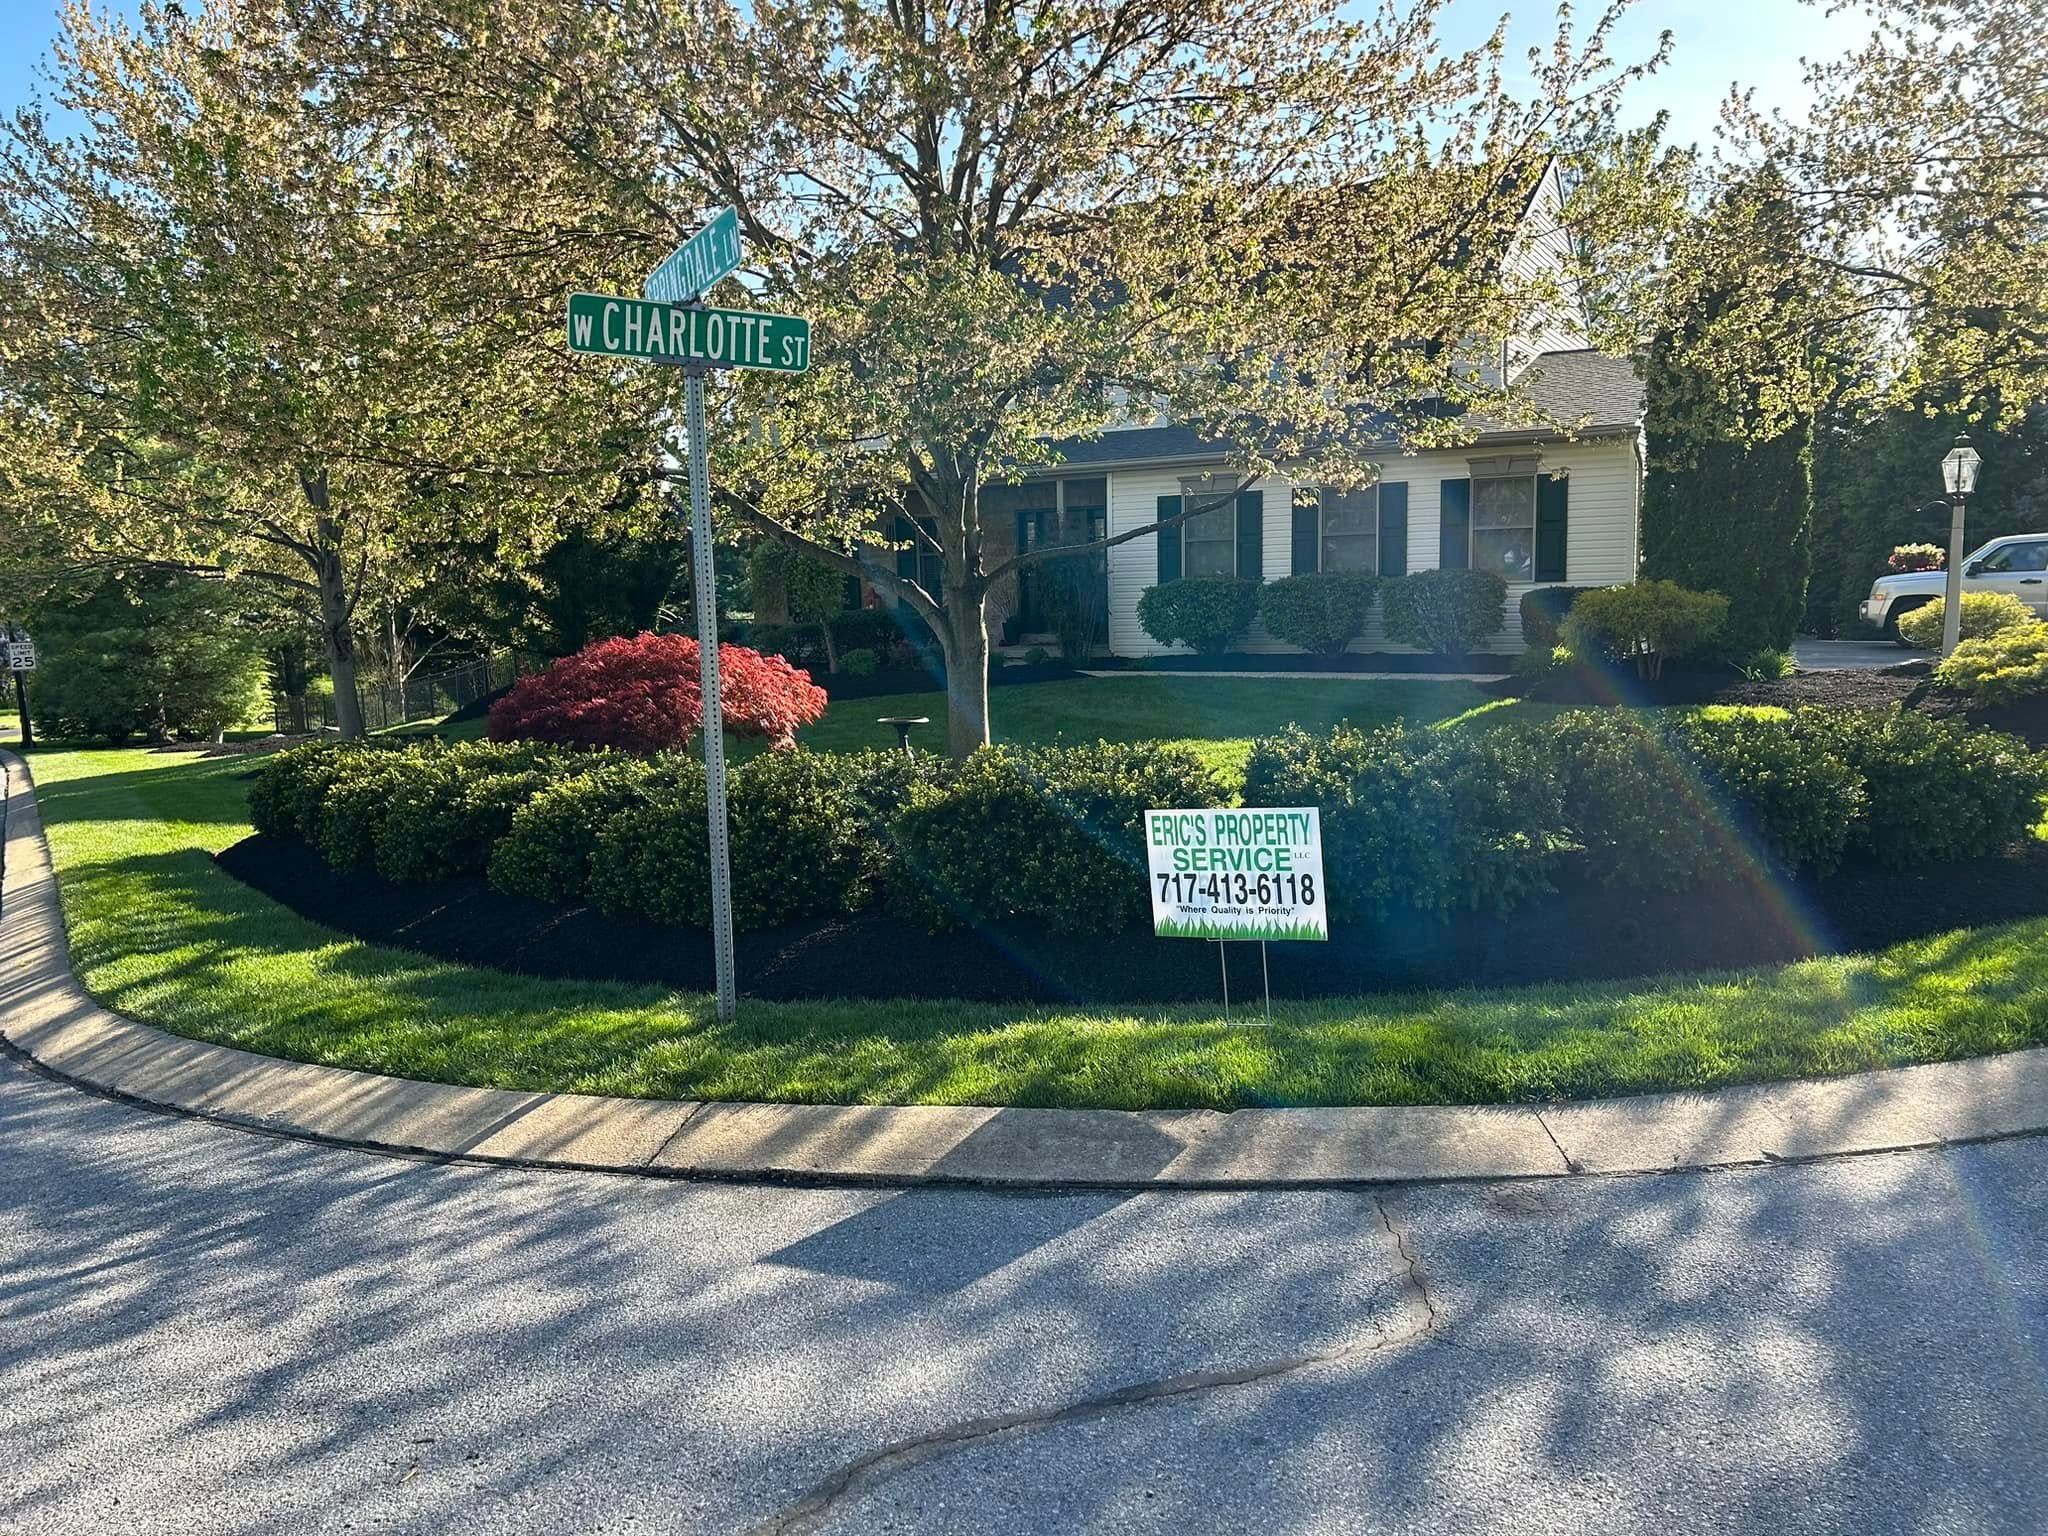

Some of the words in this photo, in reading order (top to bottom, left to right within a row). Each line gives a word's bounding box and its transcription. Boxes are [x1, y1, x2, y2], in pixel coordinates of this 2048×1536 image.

[723, 226, 739, 266] LN
[573, 314, 592, 347] W
[603, 302, 772, 365] CHARLOTTE
[781, 335, 805, 366] ST
[12, 656, 34, 667] 25
[1151, 814, 1206, 846] ERIC'S
[1214, 813, 1310, 846] PROPERTY
[1172, 848, 1292, 871] SERVICE
[1157, 873, 1315, 905] 717-413-6118
[1211, 906, 1241, 915] Quality
[1246, 906, 1254, 914] is
